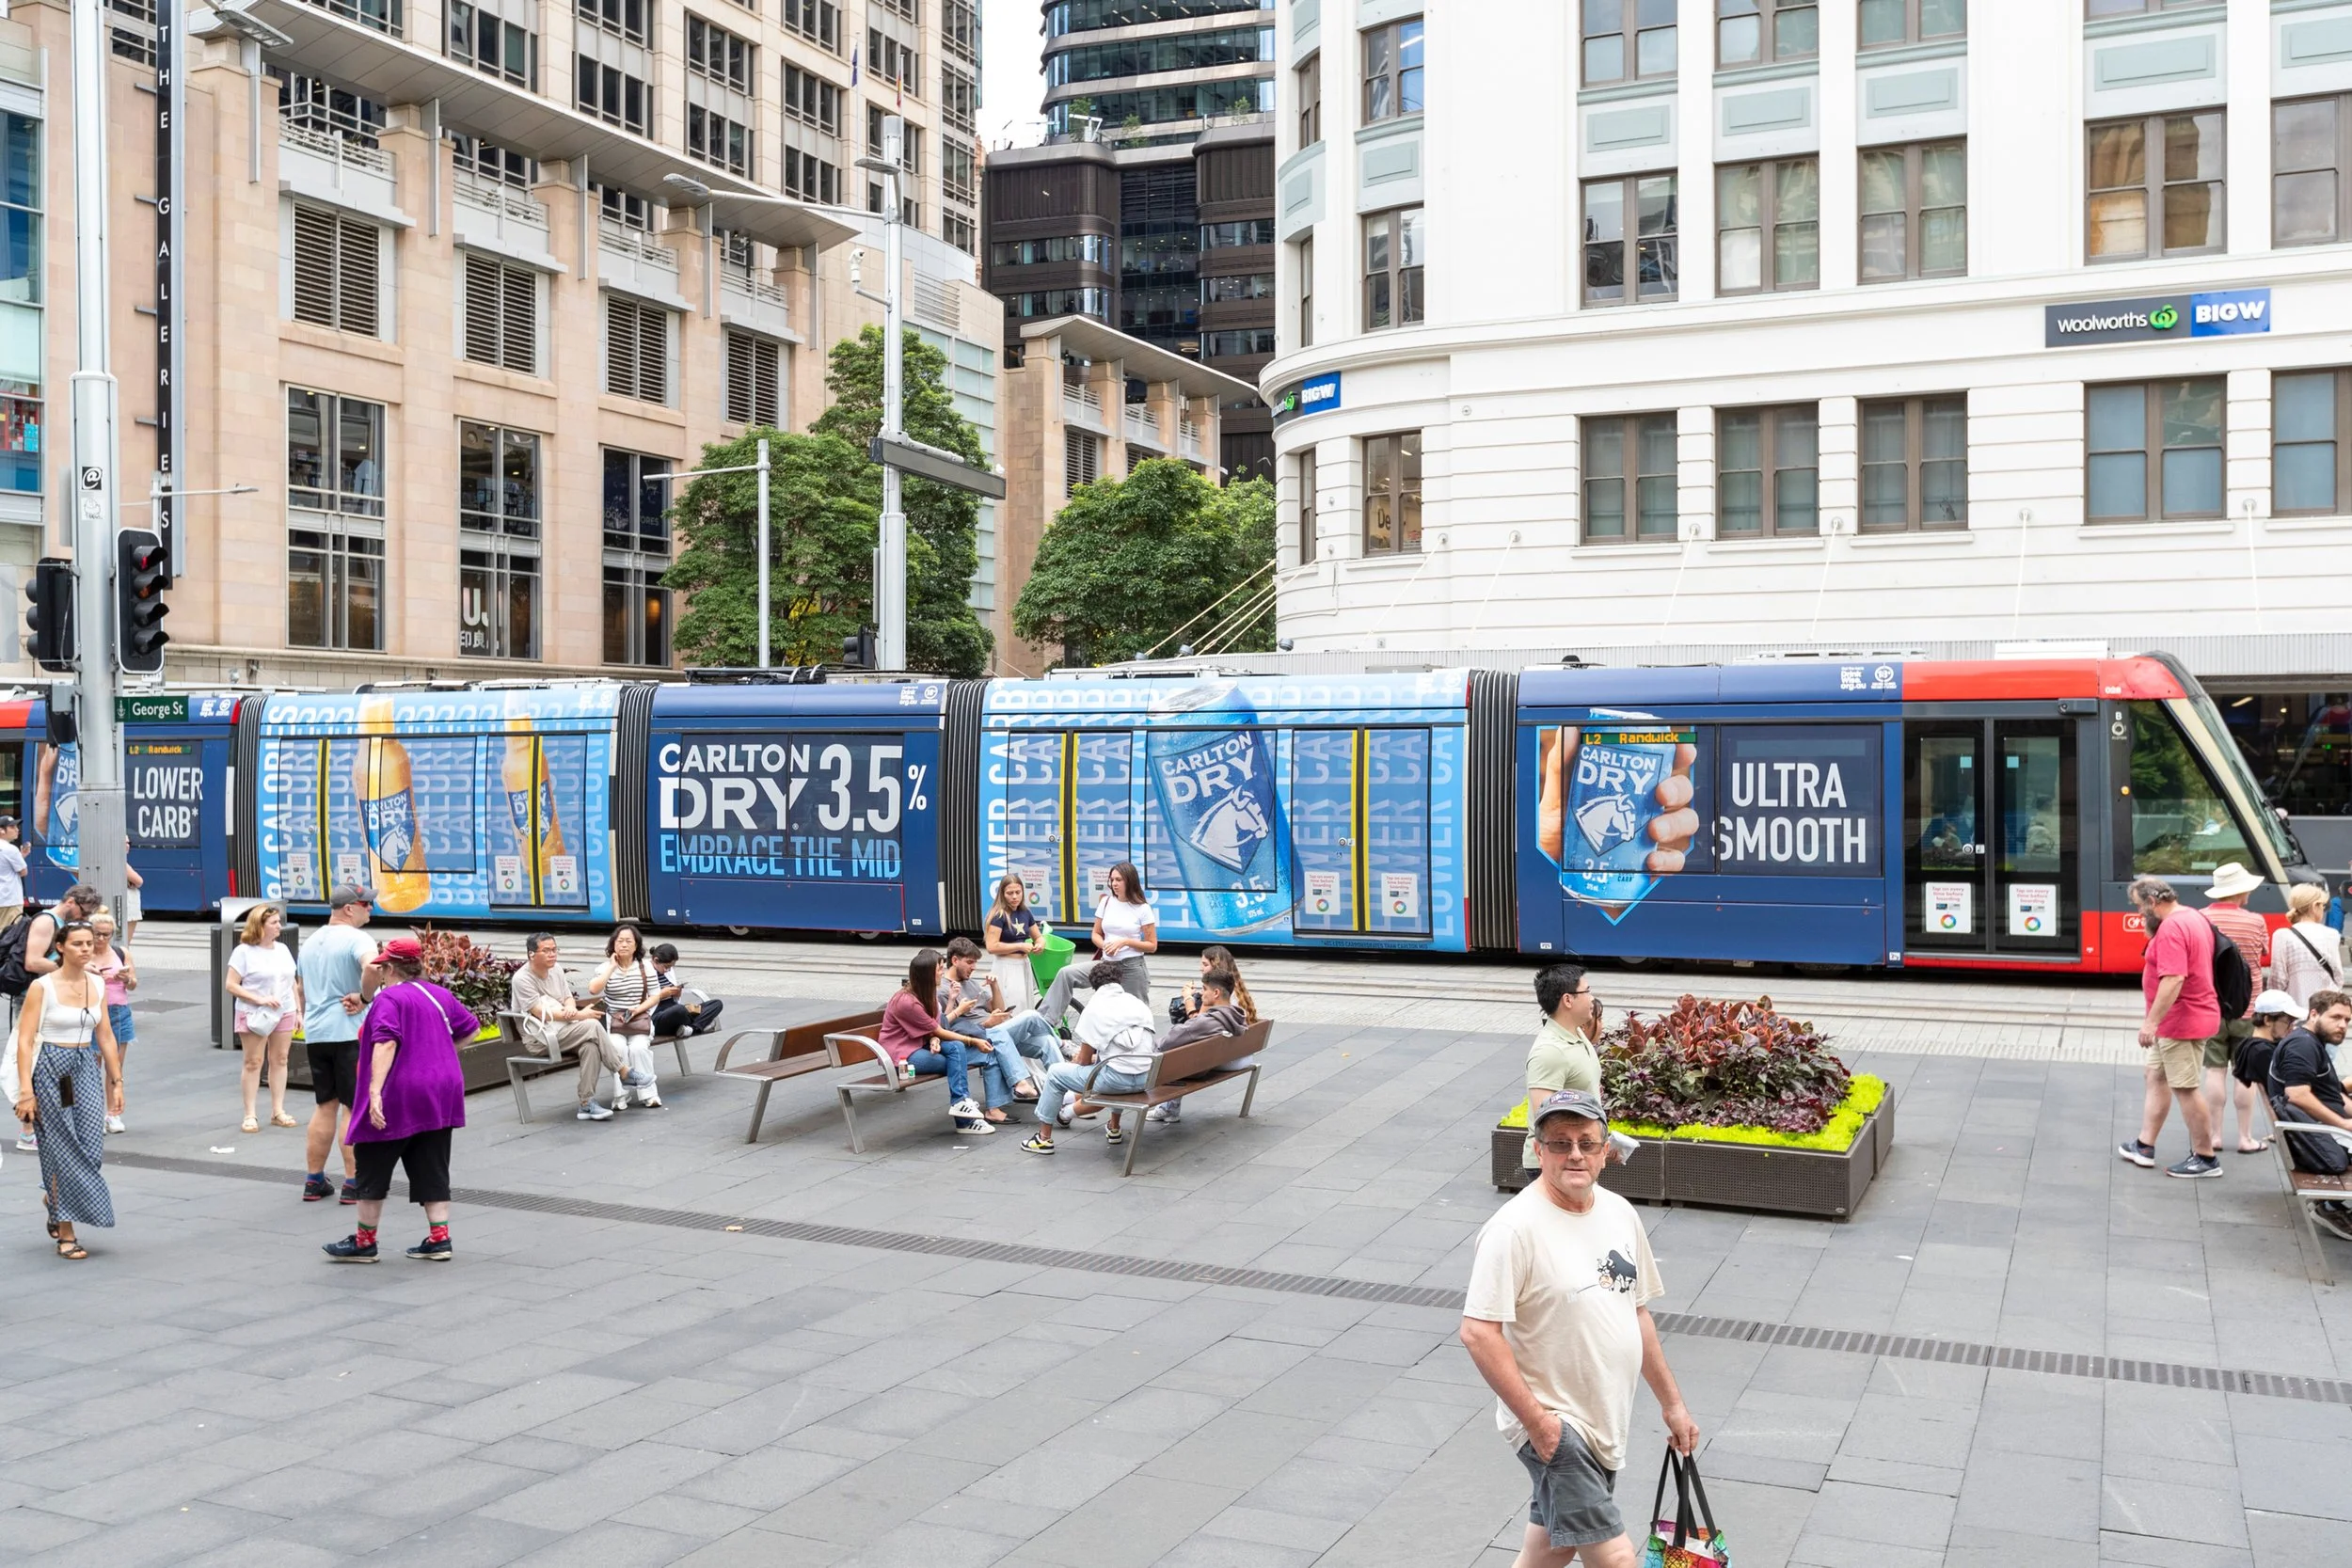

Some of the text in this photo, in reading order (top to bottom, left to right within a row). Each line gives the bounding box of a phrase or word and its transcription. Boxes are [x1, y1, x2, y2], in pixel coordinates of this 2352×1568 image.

[158, 26, 170, 529] THE GALERIES
[132, 702, 171, 719] George
[173, 701, 183, 715] St
[148, 745, 182, 754] Randwick
[1161, 731, 1252, 776] CARLTON
[1585, 732, 1679, 744] L2 Randwick
[659, 743, 810, 774] CARLTON
[1166, 747, 1257, 804] DRY
[1577, 759, 1654, 795] DRY
[1581, 746, 1657, 771] CARLTON
[134, 767, 204, 800] LOWER
[659, 777, 808, 830] DRY
[1732, 762, 1847, 808] ULTRA
[660, 834, 901, 879] EMBRACE THE MID
[1711, 816, 1867, 864] SMOOTH
